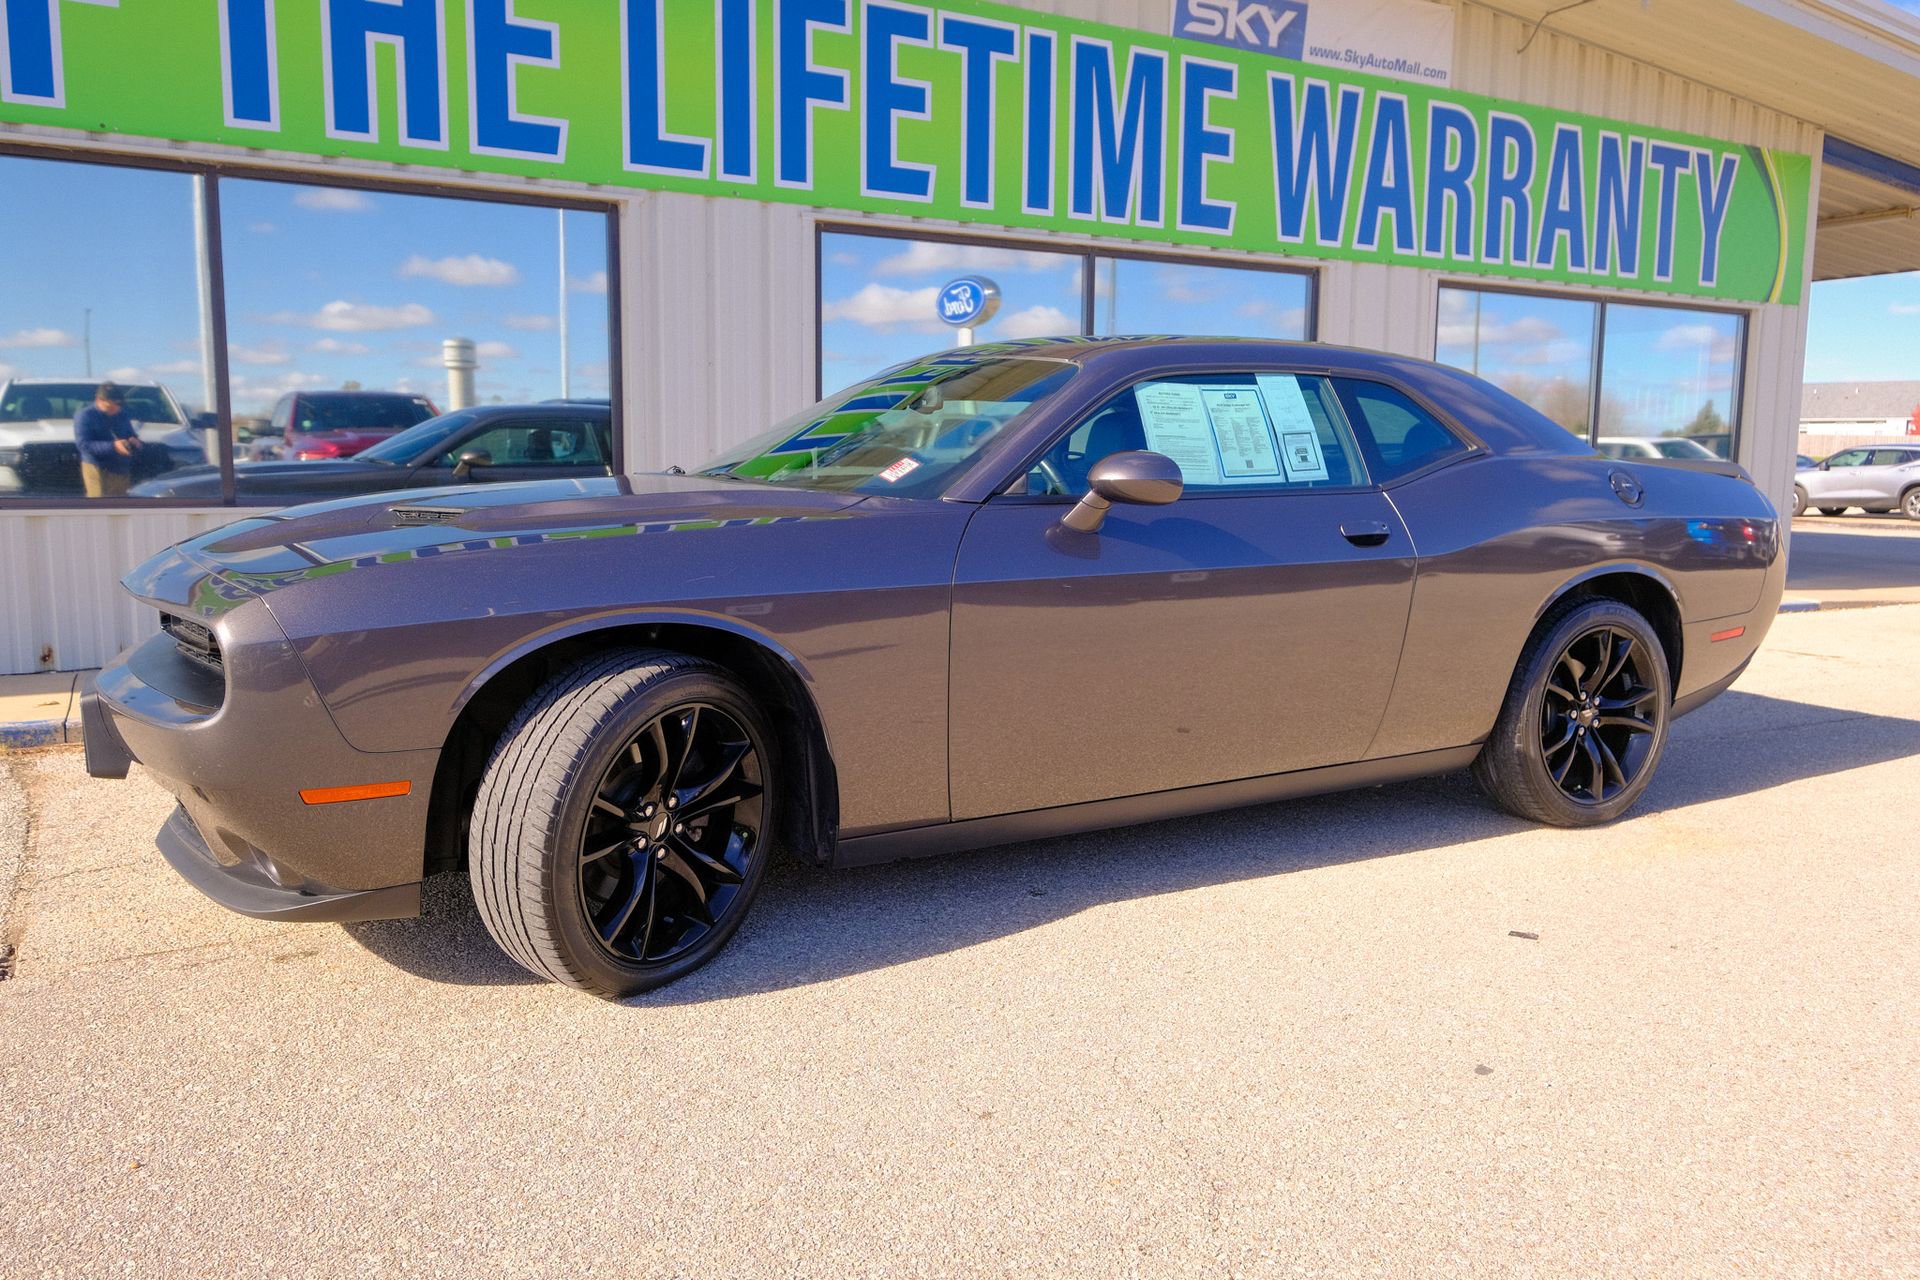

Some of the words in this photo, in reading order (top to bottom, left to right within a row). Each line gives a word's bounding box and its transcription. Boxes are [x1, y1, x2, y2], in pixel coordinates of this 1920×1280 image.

[1183, 0, 1298, 48] SKY
[1309, 46, 1448, 81] www.SkyAutoMall.com
[619, 0, 1239, 237] LIFETIME
[1266, 70, 1740, 287] WARRANTY
